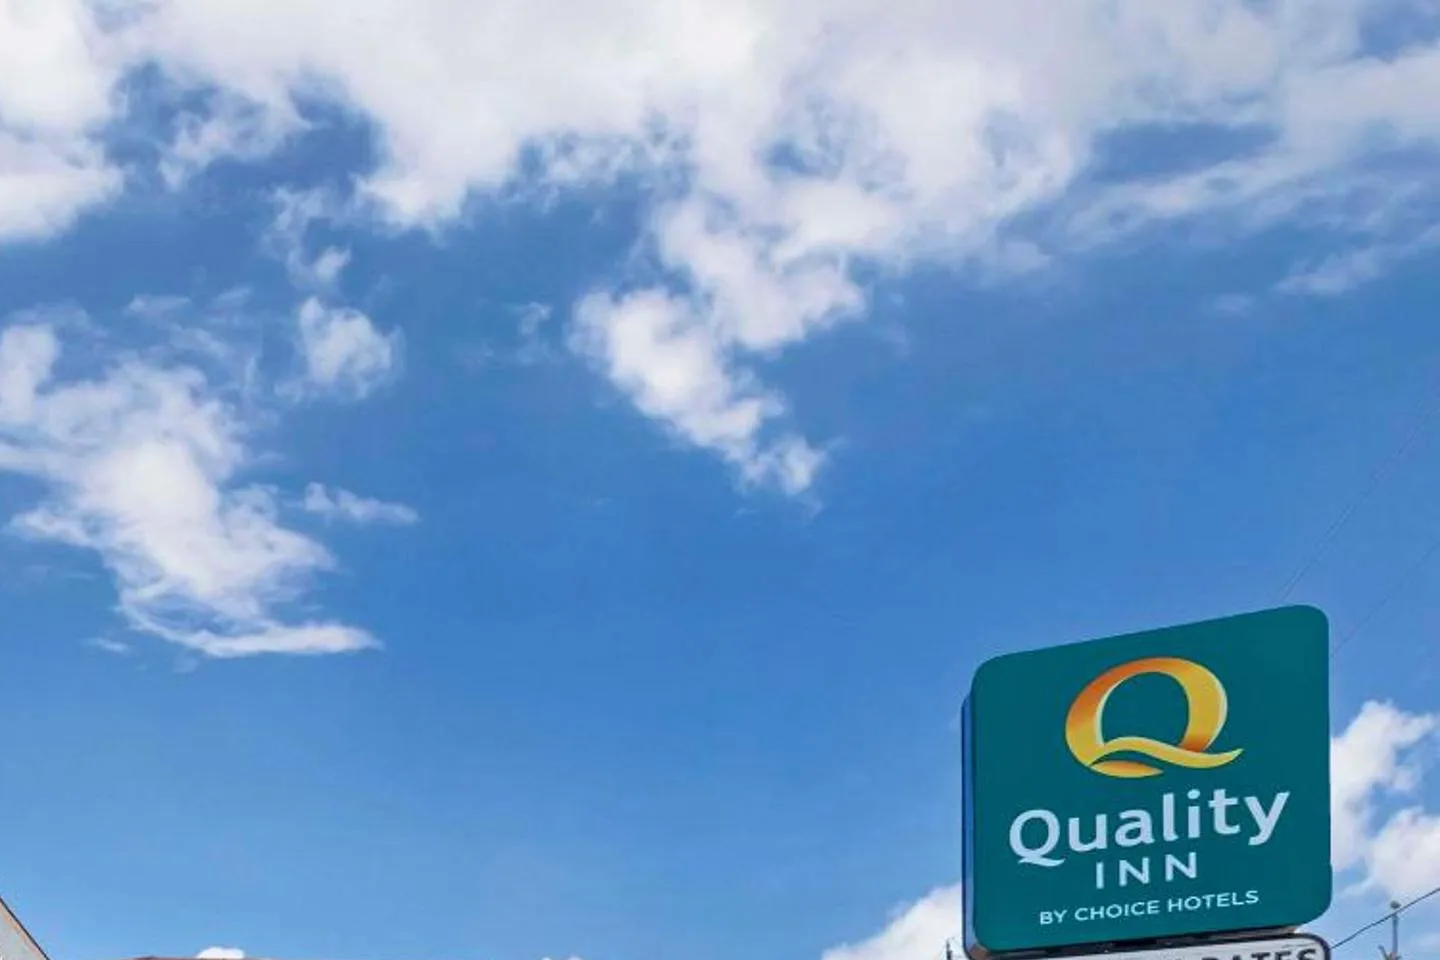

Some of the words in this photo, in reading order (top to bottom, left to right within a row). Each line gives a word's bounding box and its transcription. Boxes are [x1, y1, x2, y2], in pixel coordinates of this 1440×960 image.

[1009, 788, 1291, 867] Quality
[1095, 851, 1198, 889] INN
[1039, 909, 1068, 925] BY
[1074, 900, 1160, 922] CHOICE
[1168, 890, 1260, 913] HOTELS
